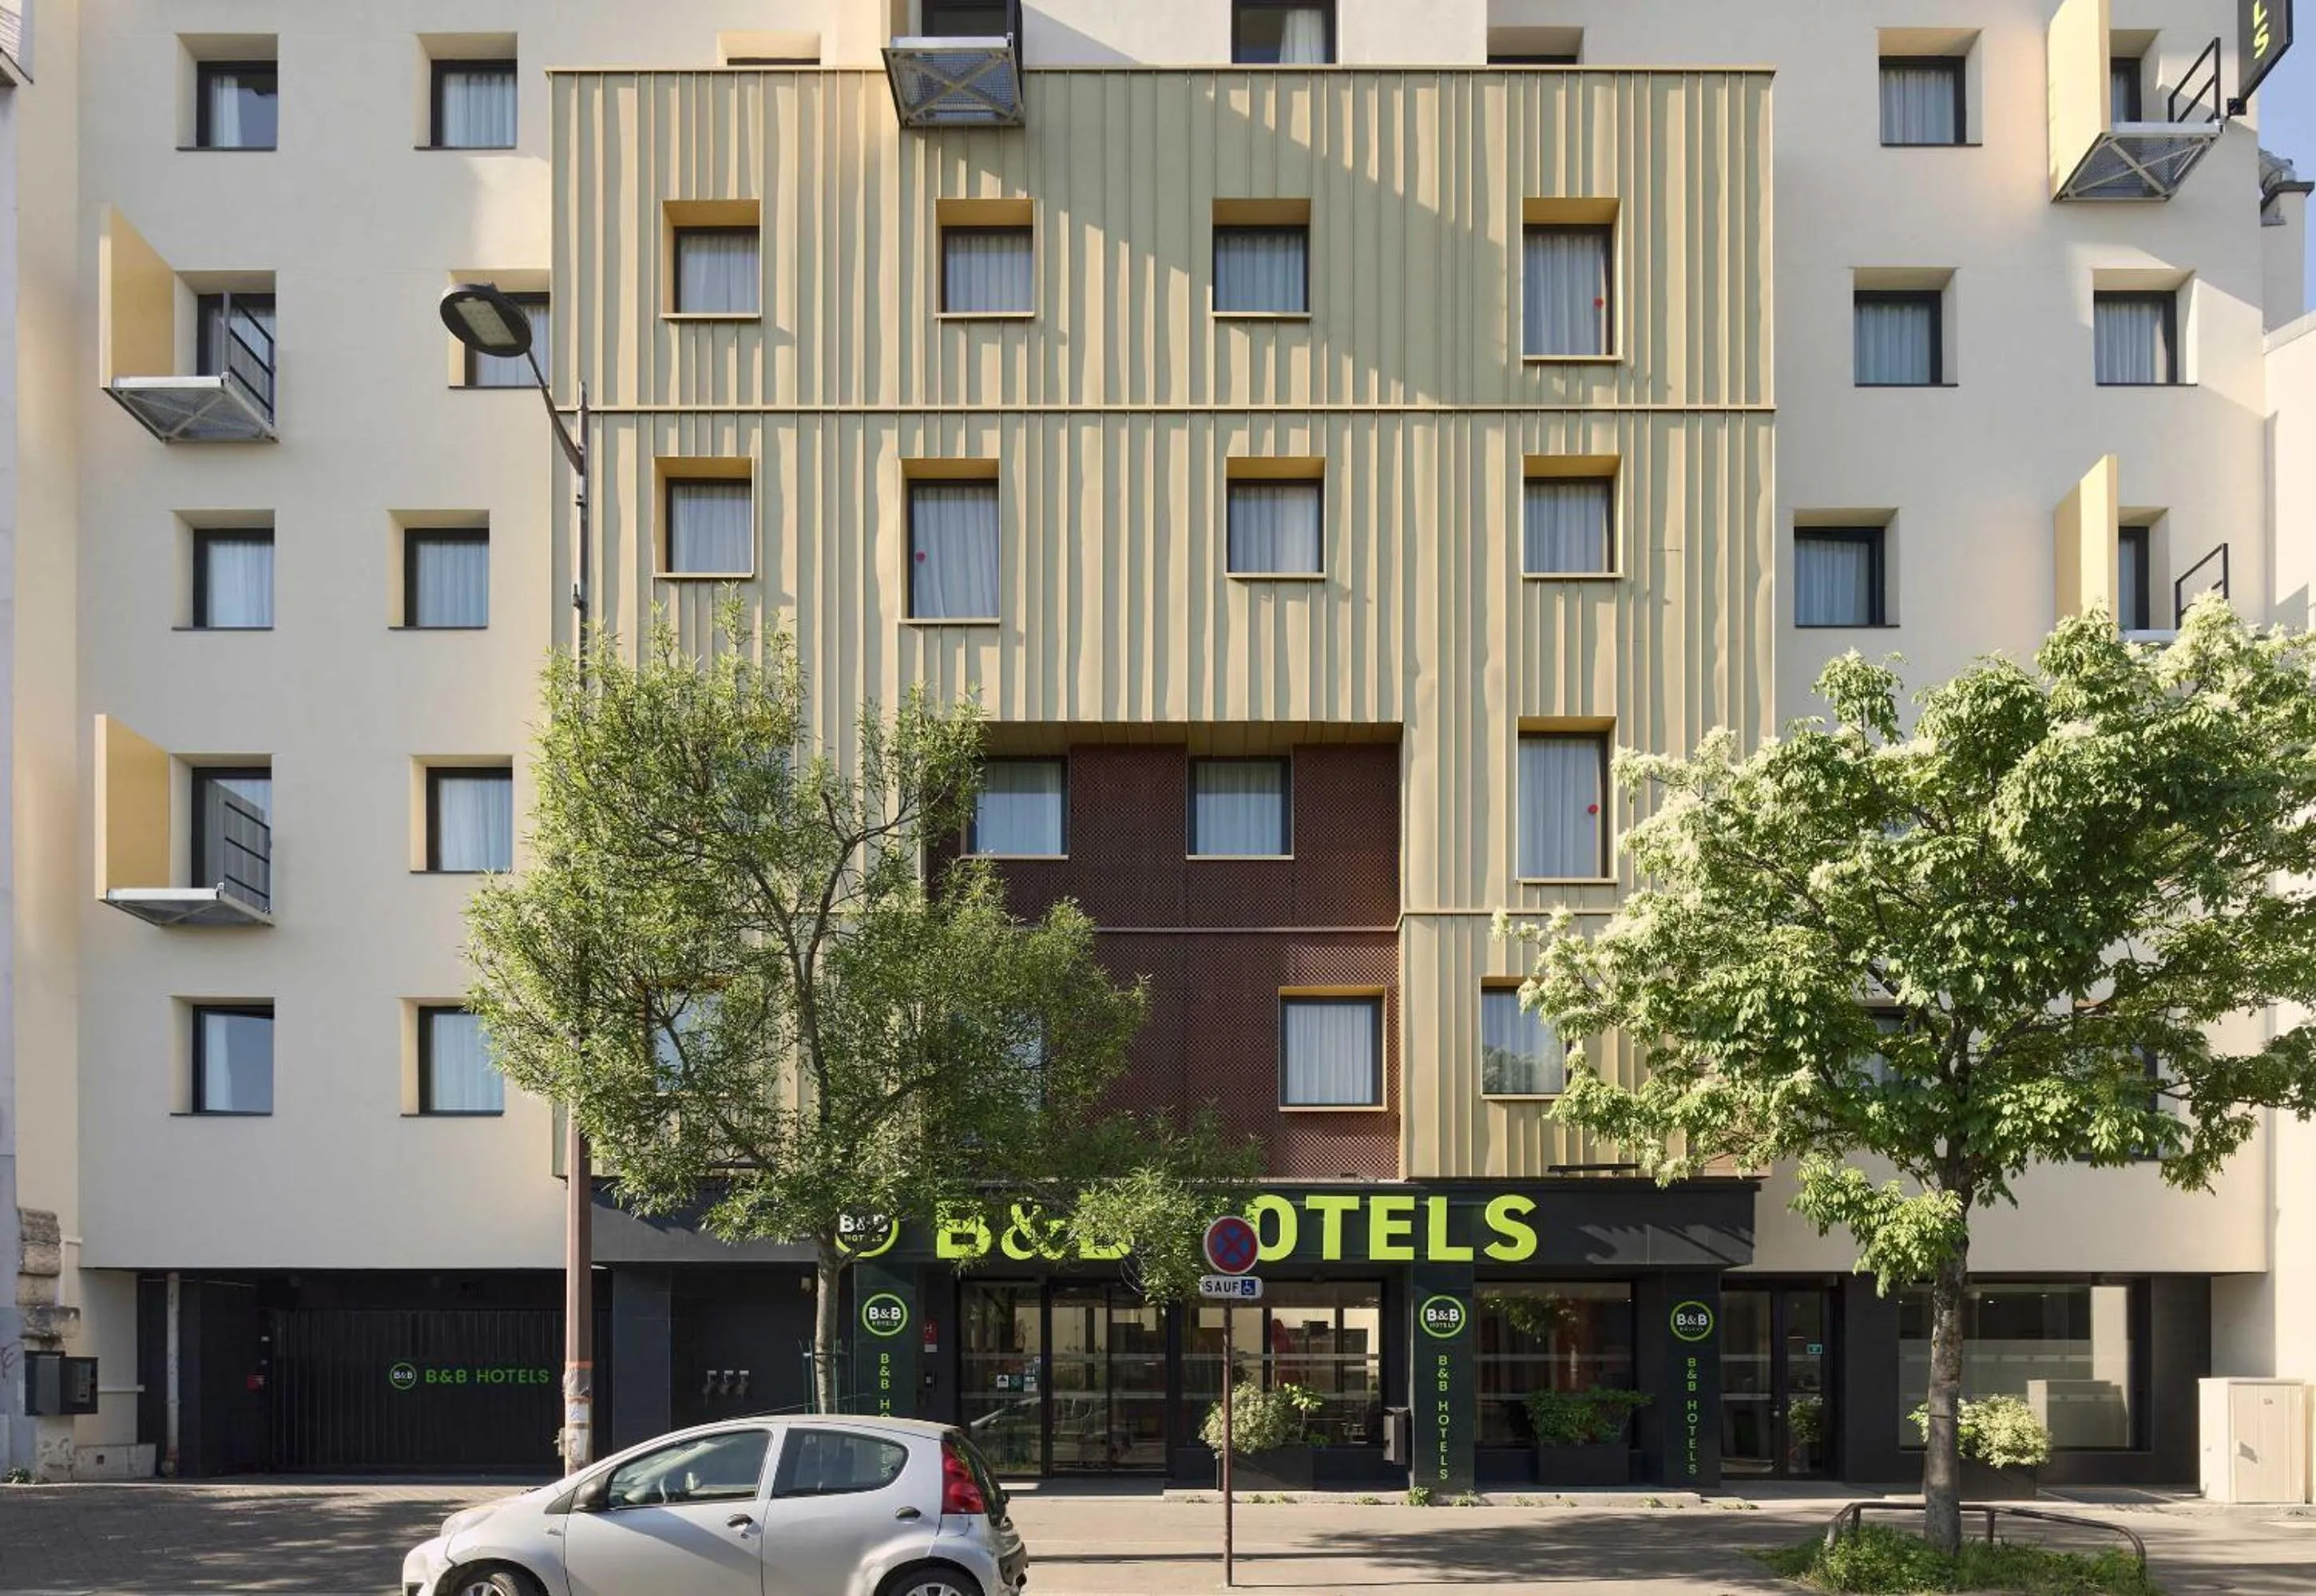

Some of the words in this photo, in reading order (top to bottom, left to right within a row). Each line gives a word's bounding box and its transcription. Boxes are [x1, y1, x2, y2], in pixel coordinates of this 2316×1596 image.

[1243, 1194, 1538, 1261] OTELS
[1205, 1281, 1239, 1293] SAUF
[868, 1307, 902, 1321] B&B
[1426, 1309, 1460, 1322] B&B
[1676, 1313, 1707, 1325] B&B
[393, 1371, 414, 1380] B&B
[425, 1369, 468, 1384] B&B
[476, 1369, 549, 1384] HOTELS
[879, 1353, 890, 1389] B&B
[1438, 1355, 1449, 1392] B&B
[1687, 1358, 1698, 1392] B&B
[1438, 1400, 1449, 1480] HOTELS
[1687, 1400, 1698, 1475] HOTELS
